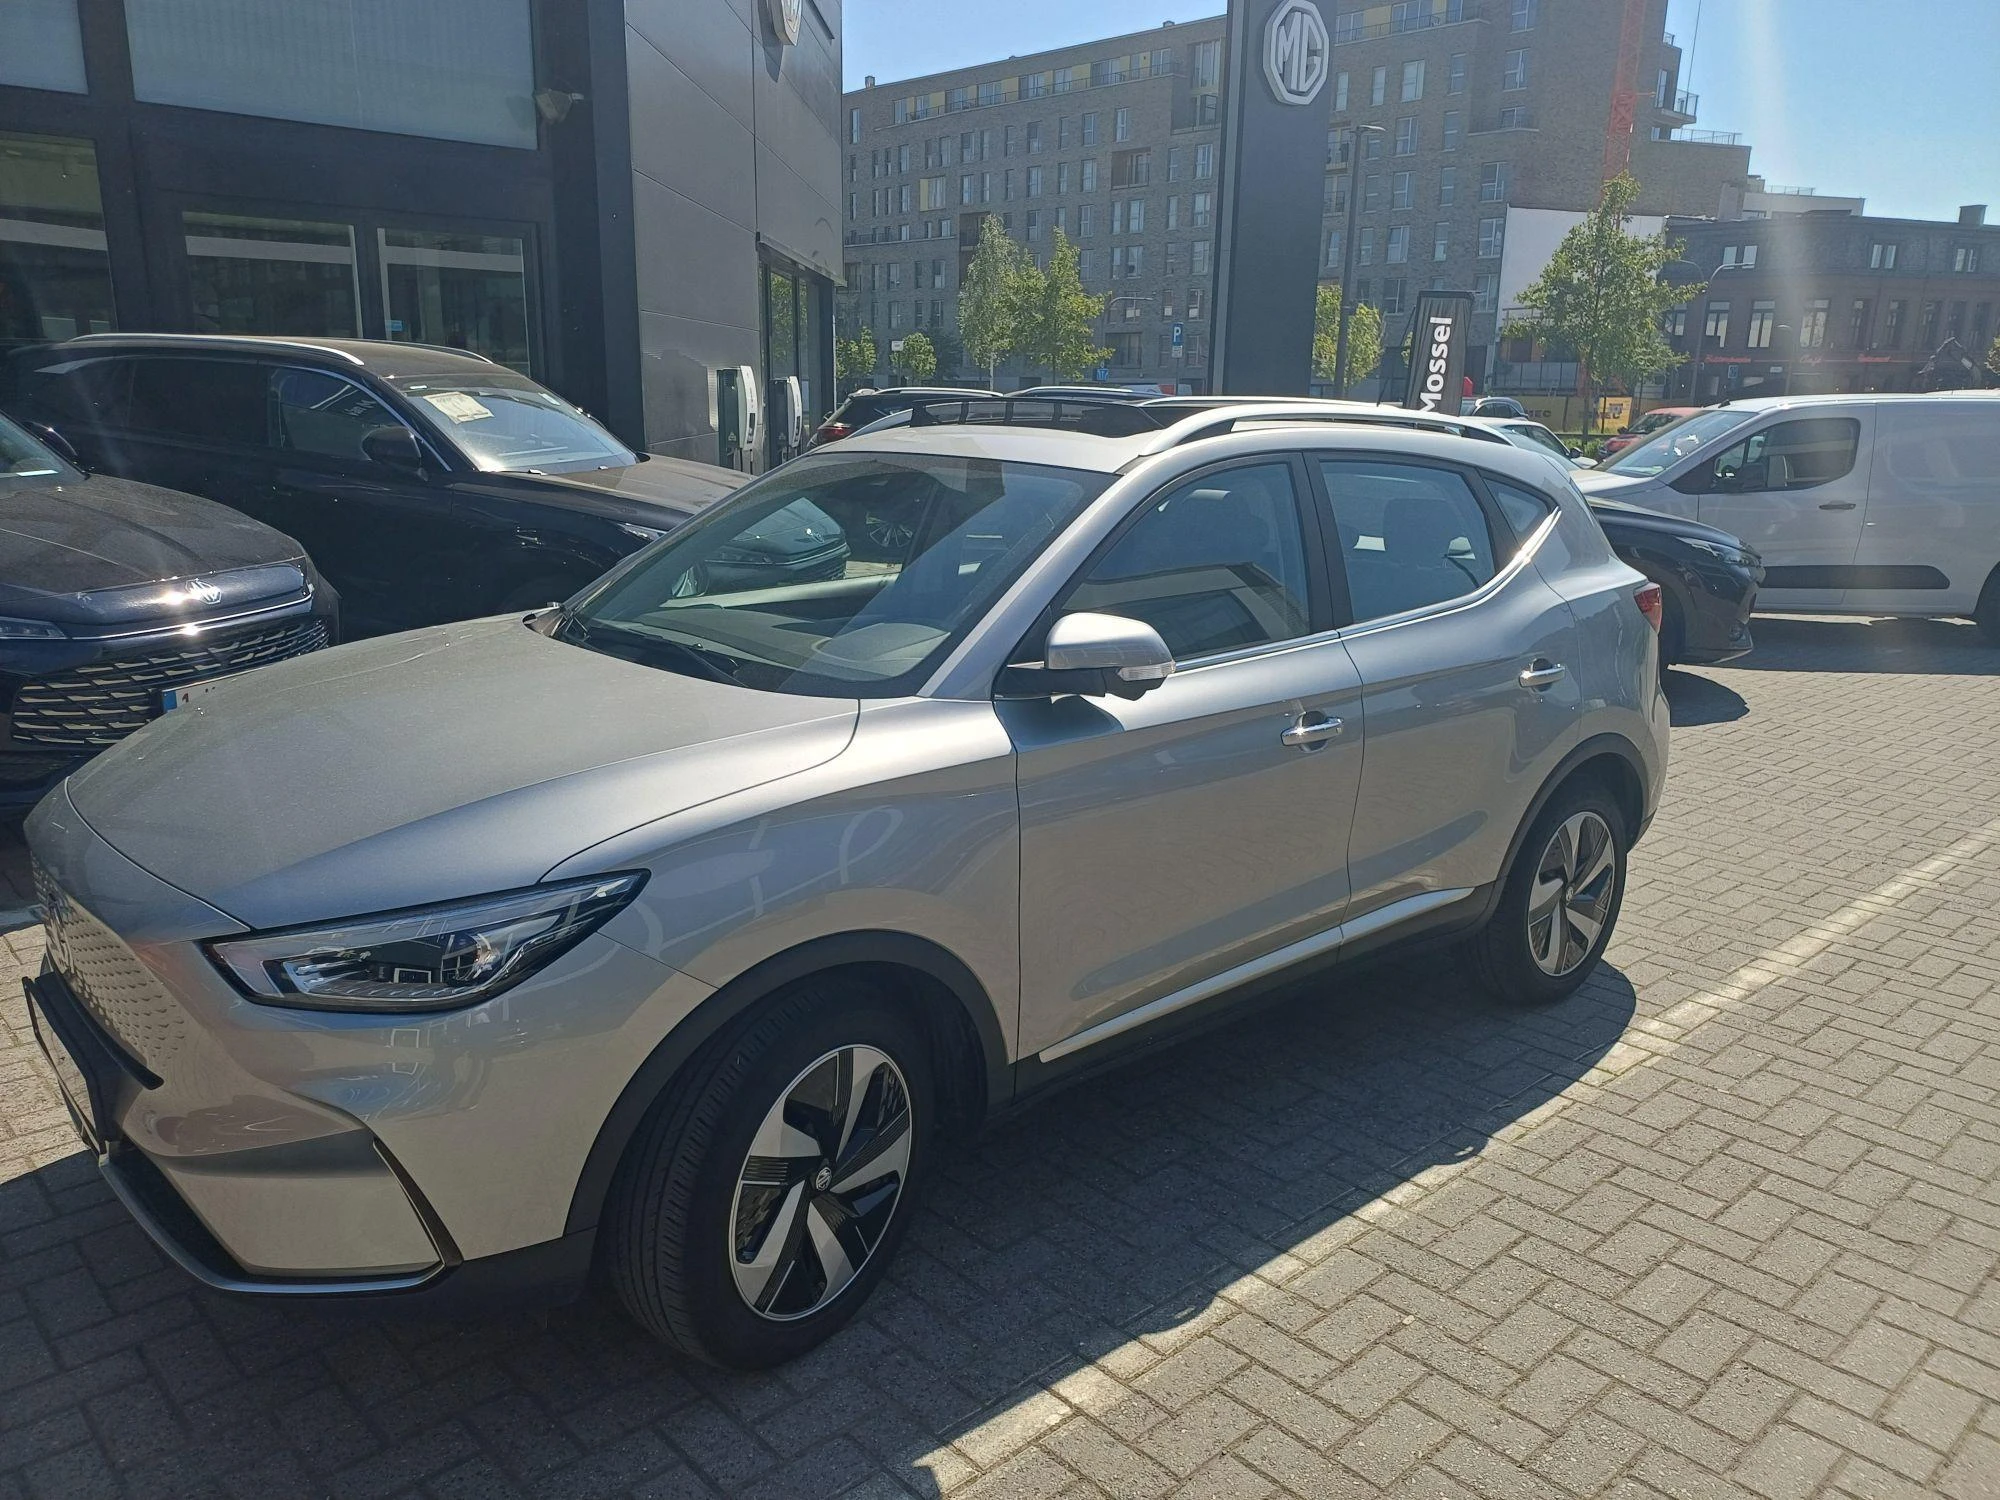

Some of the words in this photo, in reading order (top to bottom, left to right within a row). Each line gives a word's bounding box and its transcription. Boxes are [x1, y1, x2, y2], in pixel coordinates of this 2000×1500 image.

[1277, 11, 1323, 92] MG
[1173, 326, 1182, 342] P
[1420, 316, 1453, 412] Mossel
